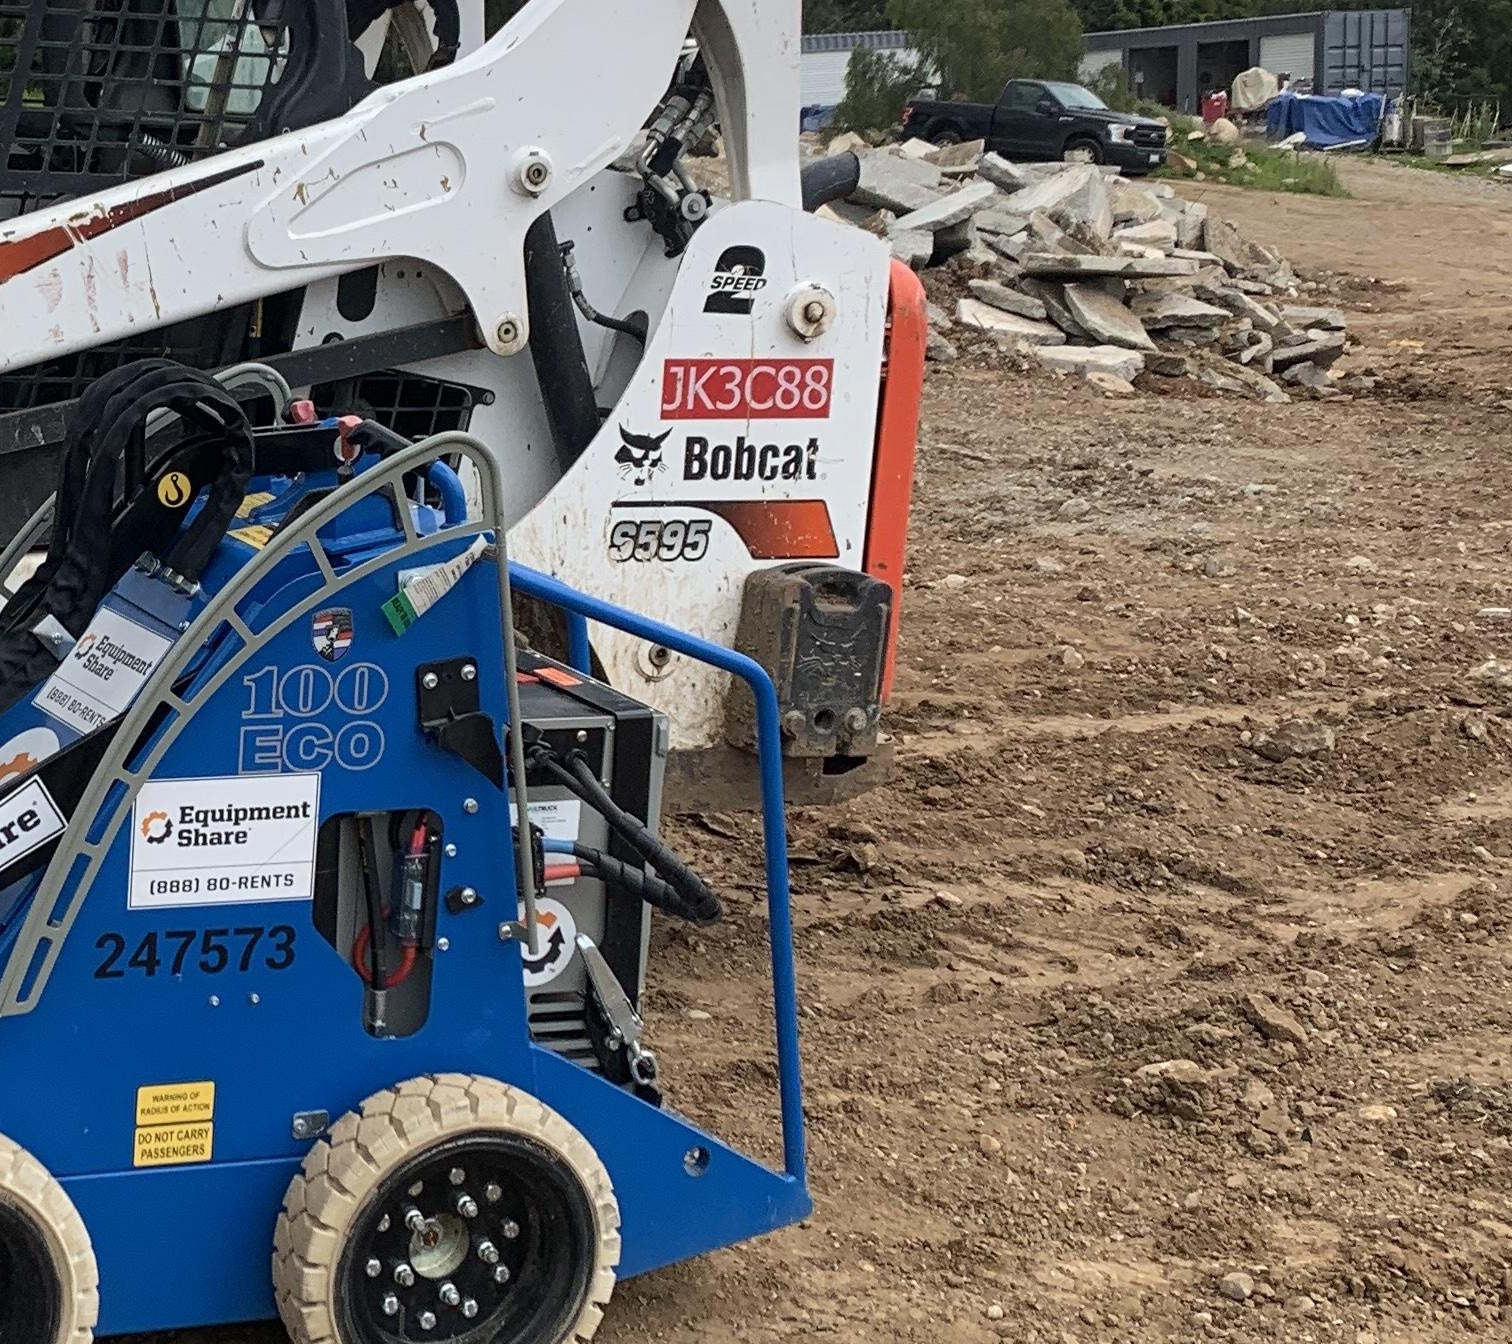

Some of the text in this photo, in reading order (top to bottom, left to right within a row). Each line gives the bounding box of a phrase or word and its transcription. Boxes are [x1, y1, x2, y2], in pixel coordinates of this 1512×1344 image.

[710, 275, 768, 293] SPEED
[662, 364, 830, 412] JK3C88
[682, 436, 820, 482] Bobcat
[608, 519, 713, 563] S595
[82, 655, 115, 681] Share
[94, 635, 154, 676] Equipment
[242, 662, 389, 720] 100
[46, 686, 107, 728] (888) 80-RENTS
[238, 720, 386, 775] ECO
[178, 800, 312, 826] Equipment
[177, 828, 248, 848] Share
[149, 872, 295, 896] (888) 80-RENTS
[93, 924, 297, 979] 247573
[140, 1103, 210, 1116] RADIUS OF ACTION
[152, 1091, 200, 1103] WARNING OF
[138, 1128, 210, 1145] DO NOT CARRY
[141, 1144, 205, 1160] PASSENGERS
